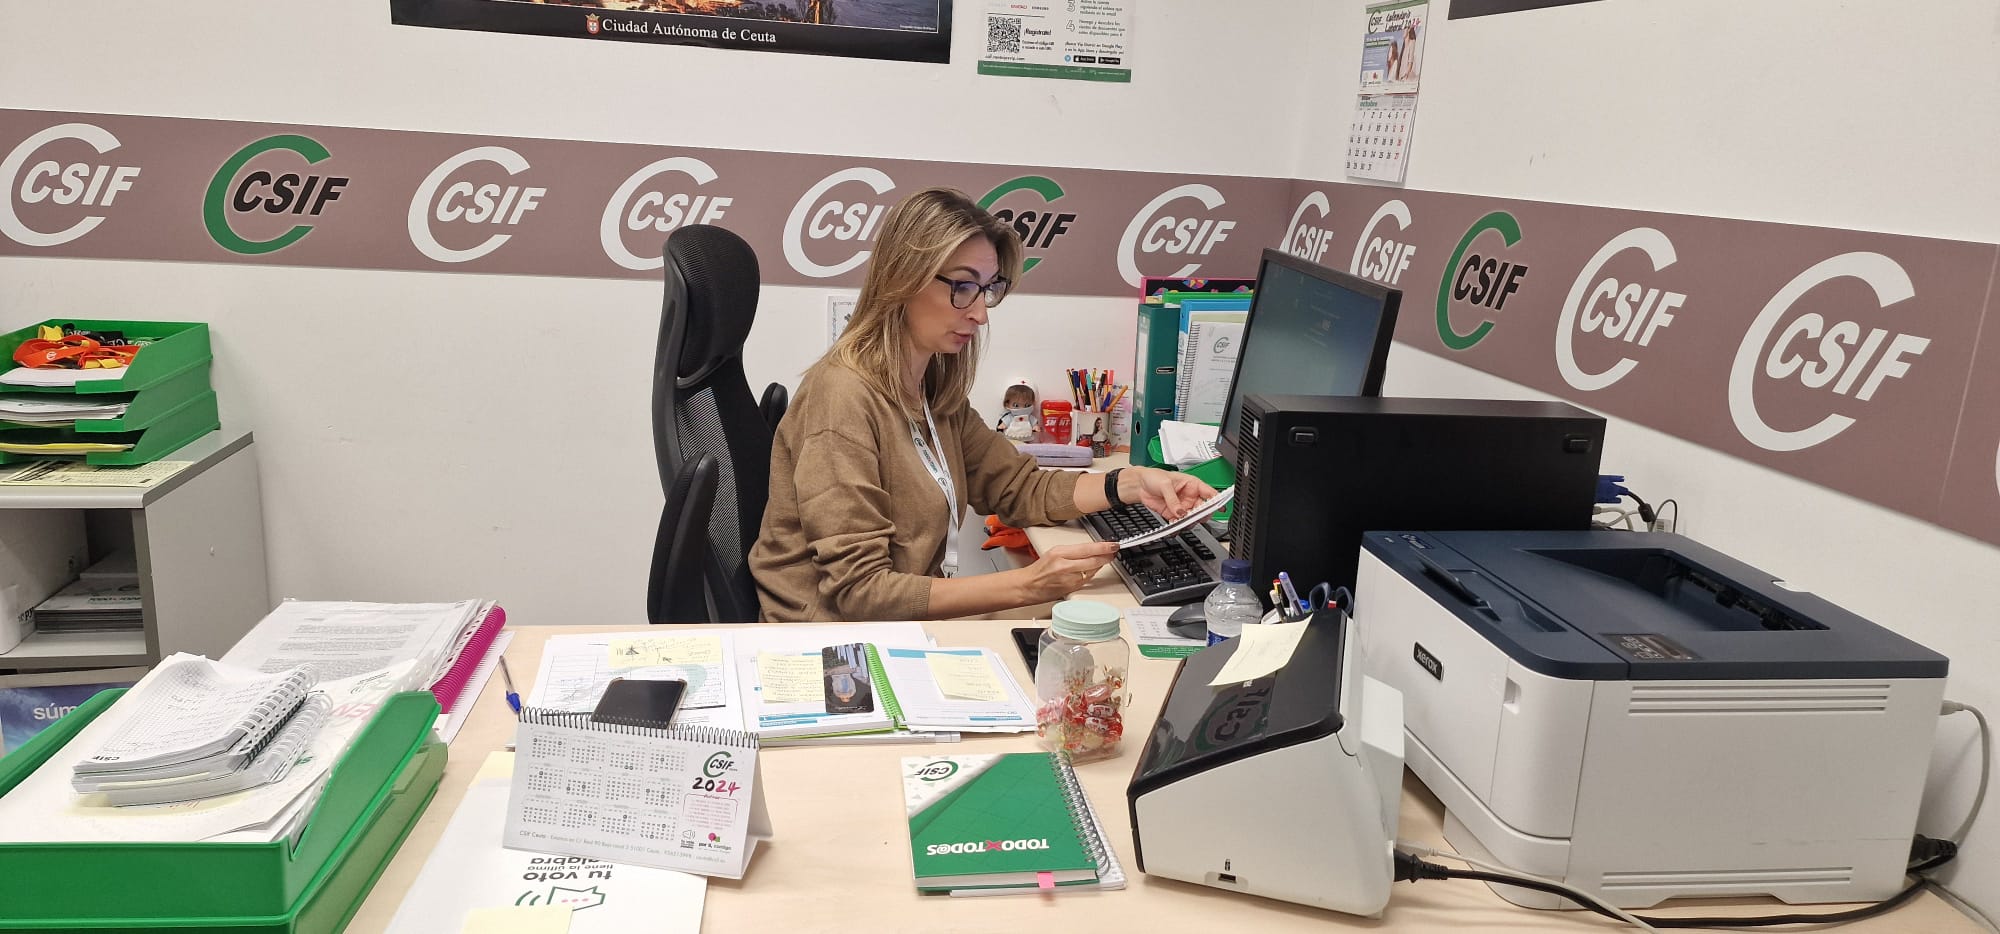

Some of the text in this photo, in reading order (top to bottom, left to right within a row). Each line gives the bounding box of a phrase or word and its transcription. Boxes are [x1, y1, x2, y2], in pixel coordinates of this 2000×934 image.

[602, 18, 776, 43] Ciudad Autónoma de Ceuta
[20, 160, 142, 207] CSIF
[233, 170, 349, 217] CSIF
[436, 181, 547, 226] CSIF
[628, 192, 734, 232] CSIF
[809, 200, 892, 241] CSI
[1142, 216, 1236, 255] CSIF
[1290, 224, 1334, 264] CSIF
[1362, 236, 1416, 285] CSIF
[1455, 254, 1528, 311] CSIF
[1580, 276, 1686, 347] CSIF
[1765, 312, 1931, 402] CSIF
[1417, 648, 1438, 673] xerox
[710, 758, 735, 770] CSIF
[914, 767, 950, 776] CSIF
[692, 777, 740, 796] 2024
[523, 871, 612, 882] tu voto
[530, 857, 600, 865] alabra
